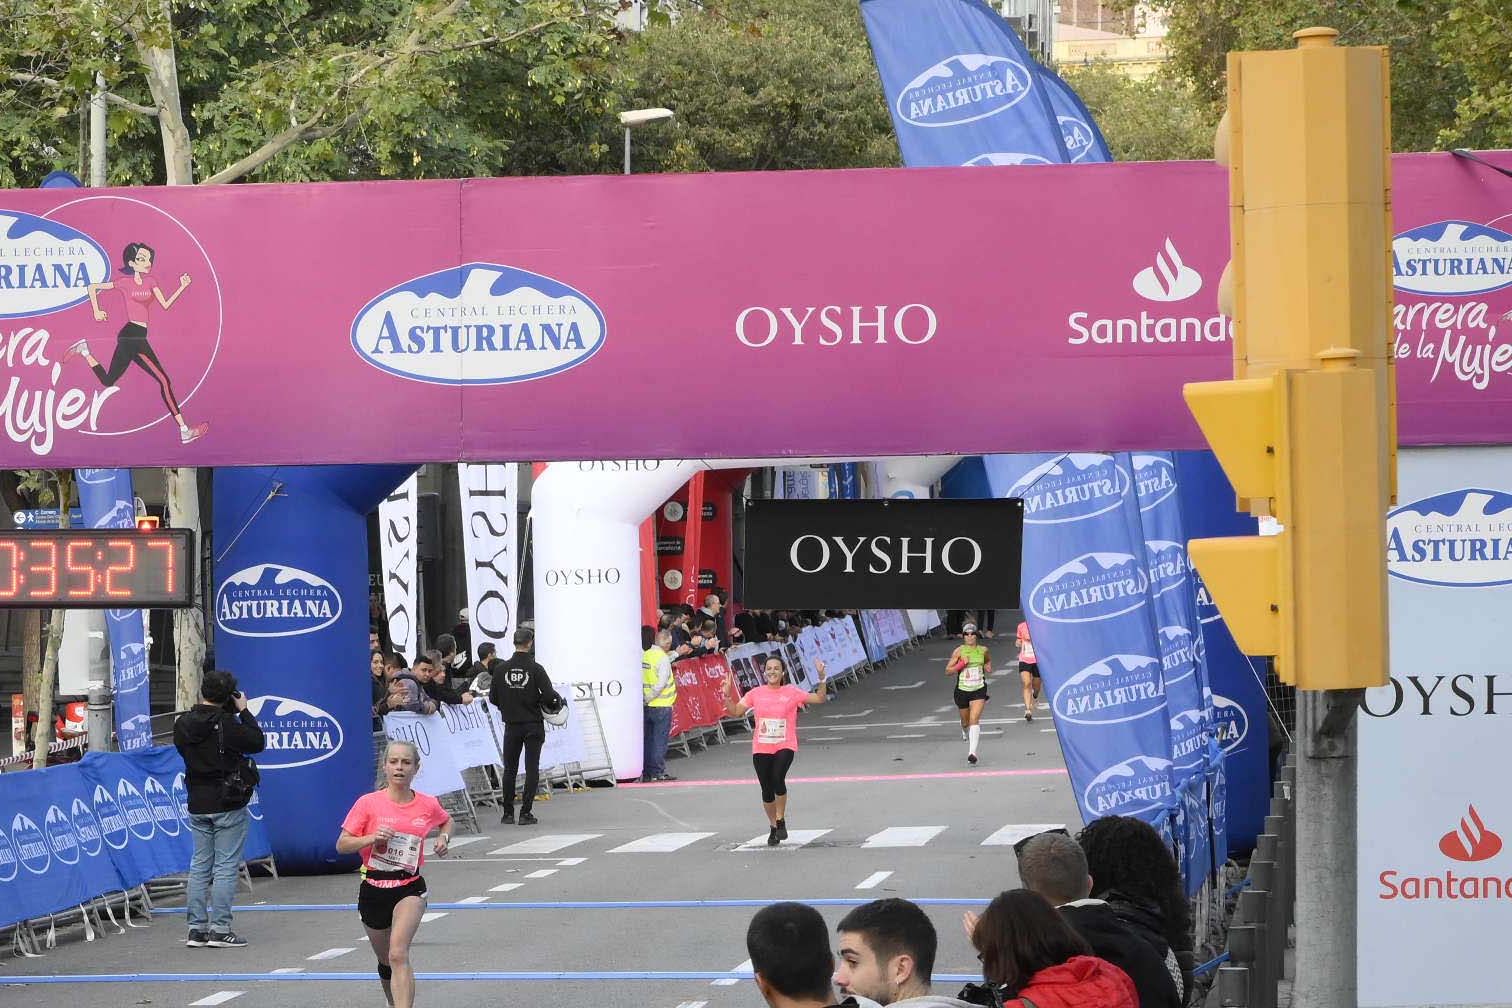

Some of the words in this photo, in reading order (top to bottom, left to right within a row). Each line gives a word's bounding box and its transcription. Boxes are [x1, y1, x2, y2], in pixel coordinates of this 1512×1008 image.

[14, 246, 85, 257] LECHERA
[410, 306, 488, 319] CENTRAL
[497, 304, 577, 316] LECHERA
[735, 303, 937, 348] OYSHO
[1393, 302, 1489, 330] arrera
[371, 310, 586, 354] ASTURIANA
[1068, 309, 1233, 345] Santand
[1416, 330, 1434, 359] la
[1430, 325, 1512, 390] Muje
[1414, 523, 1481, 533] CENTRAL
[789, 534, 982, 576] OYSHO
[545, 567, 621, 587] OYSHO
[233, 589, 274, 597] CENTRAL
[279, 588, 328, 597] LECHERA
[220, 593, 333, 621] ASTURIANA
[511, 673, 524, 683] BP
[575, 680, 622, 698] SHO
[1358, 674, 1512, 717] OYSH
[279, 720, 329, 728] LECHERA
[1379, 870, 1512, 900] Santan
